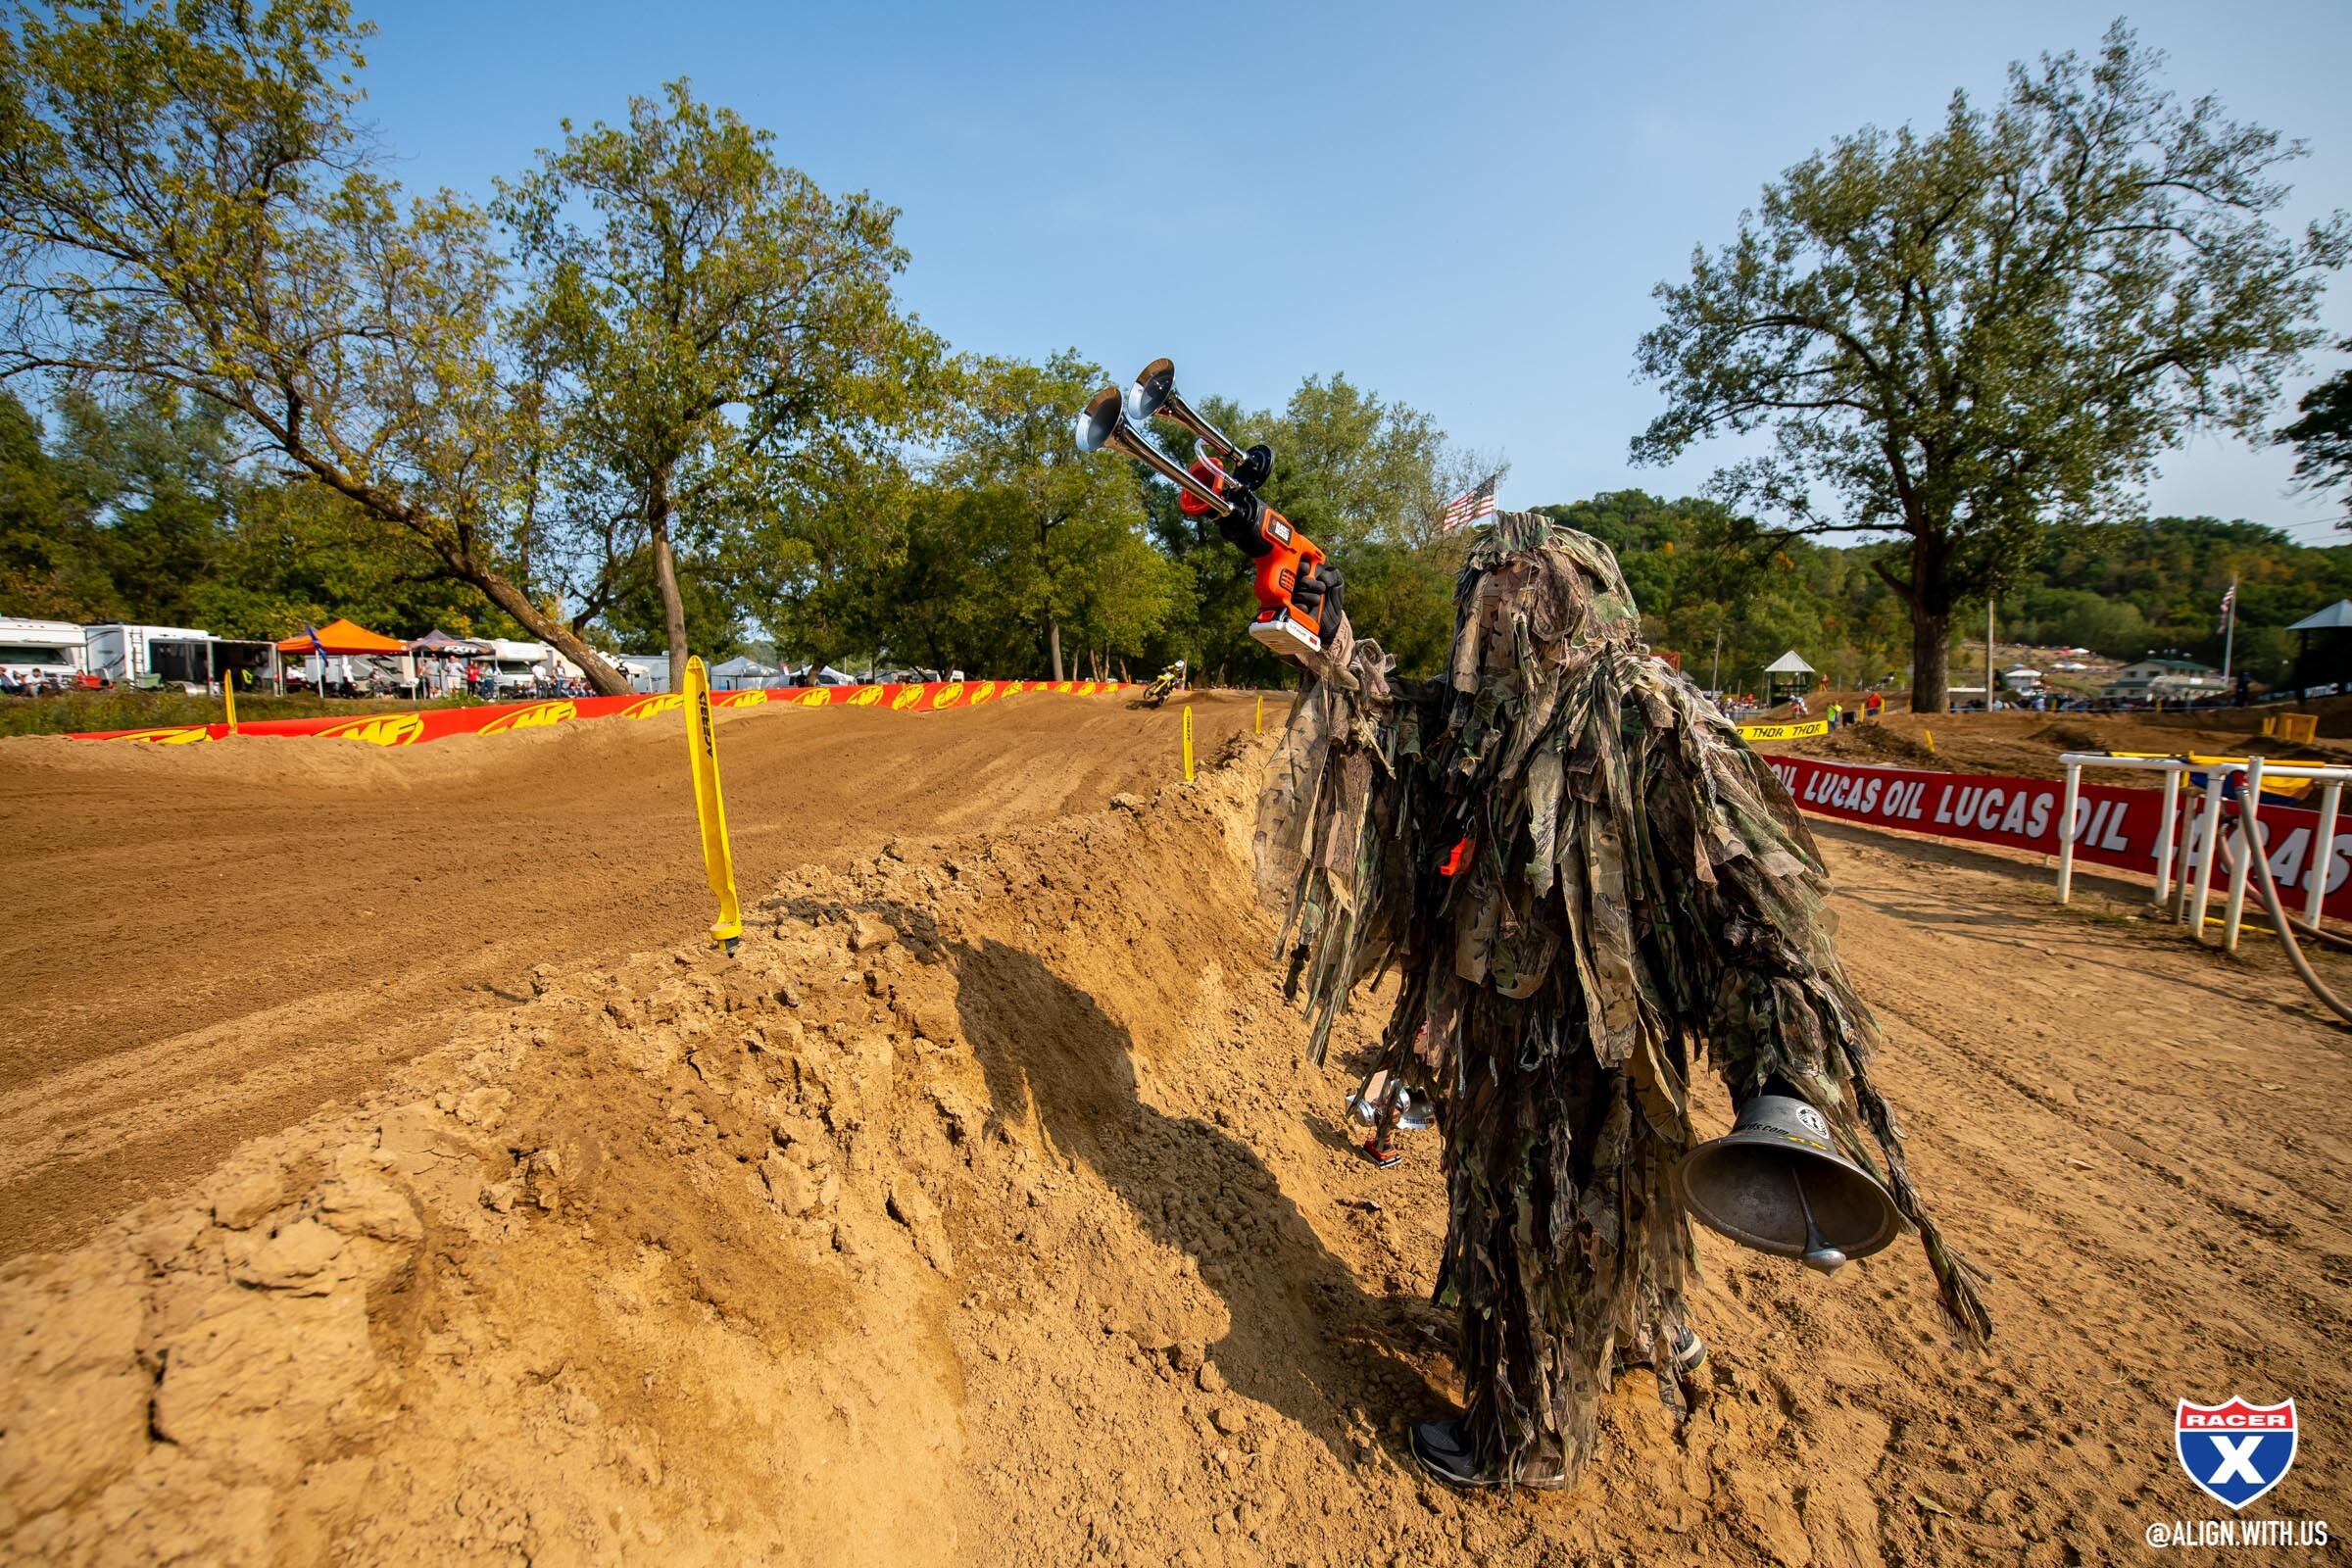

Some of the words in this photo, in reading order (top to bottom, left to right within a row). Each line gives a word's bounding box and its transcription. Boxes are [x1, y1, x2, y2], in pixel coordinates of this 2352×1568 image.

[1752, 728, 1784, 737] THOR
[1792, 724, 1821, 736] THOR
[1803, 770, 1882, 813] LUCAS
[1882, 780, 1926, 820] OIL
[1935, 785, 2055, 839] LUCAS
